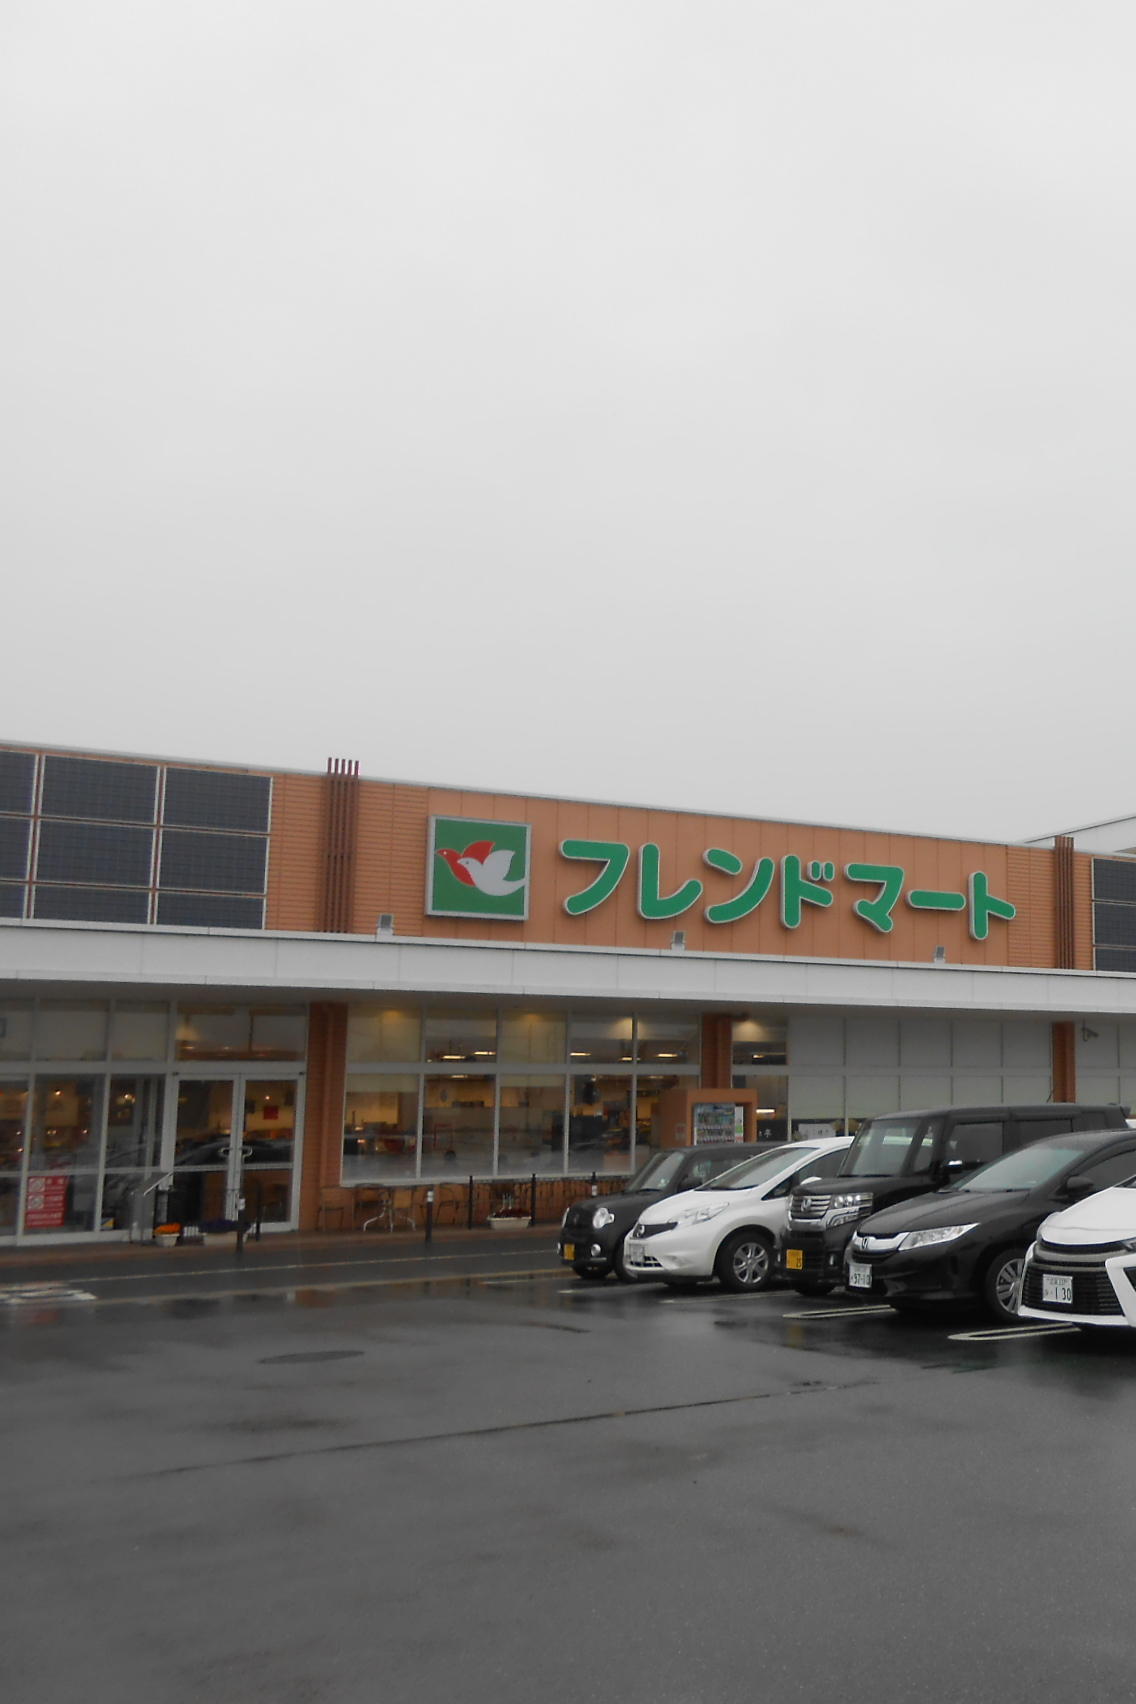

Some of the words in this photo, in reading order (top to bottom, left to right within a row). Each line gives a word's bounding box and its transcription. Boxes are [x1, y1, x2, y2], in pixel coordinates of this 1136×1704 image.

[559, 838, 1017, 941] フレンドマート
